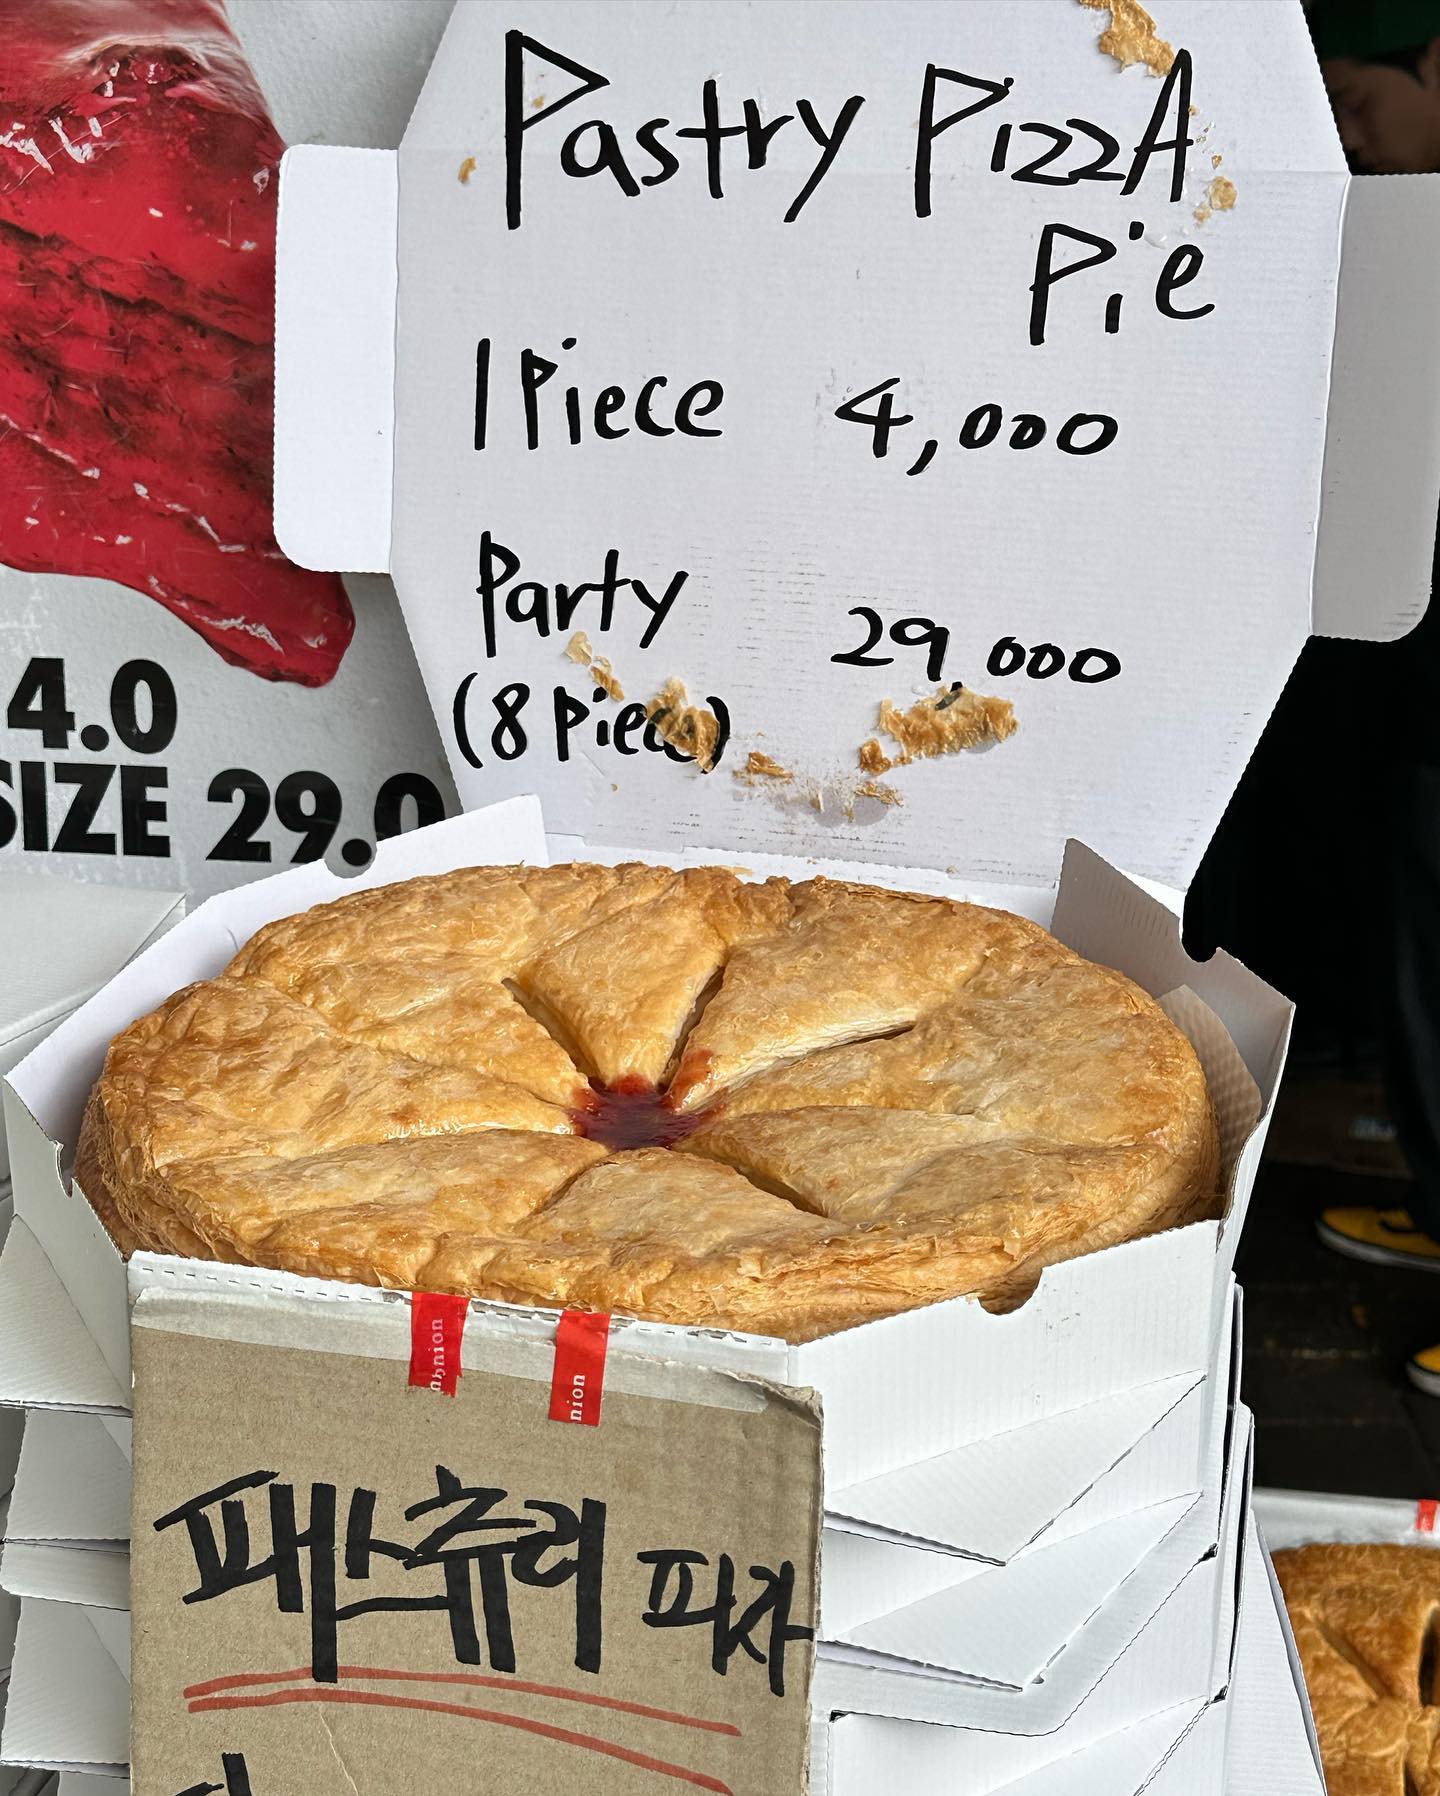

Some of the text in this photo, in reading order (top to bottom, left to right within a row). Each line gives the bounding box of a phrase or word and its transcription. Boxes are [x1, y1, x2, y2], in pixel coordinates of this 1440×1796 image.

[504, 29, 866, 230] Pastry
[1028, 220, 1216, 346] Pie
[474, 336, 1119, 477] 1 Piece 4,000
[475, 530, 690, 659] Party
[6, 657, 178, 755] 4.0
[452, 672, 530, 769] (8
[205, 768, 447, 868] 29.0
[152, 1464, 816, 1698] 패스츄리 피자
